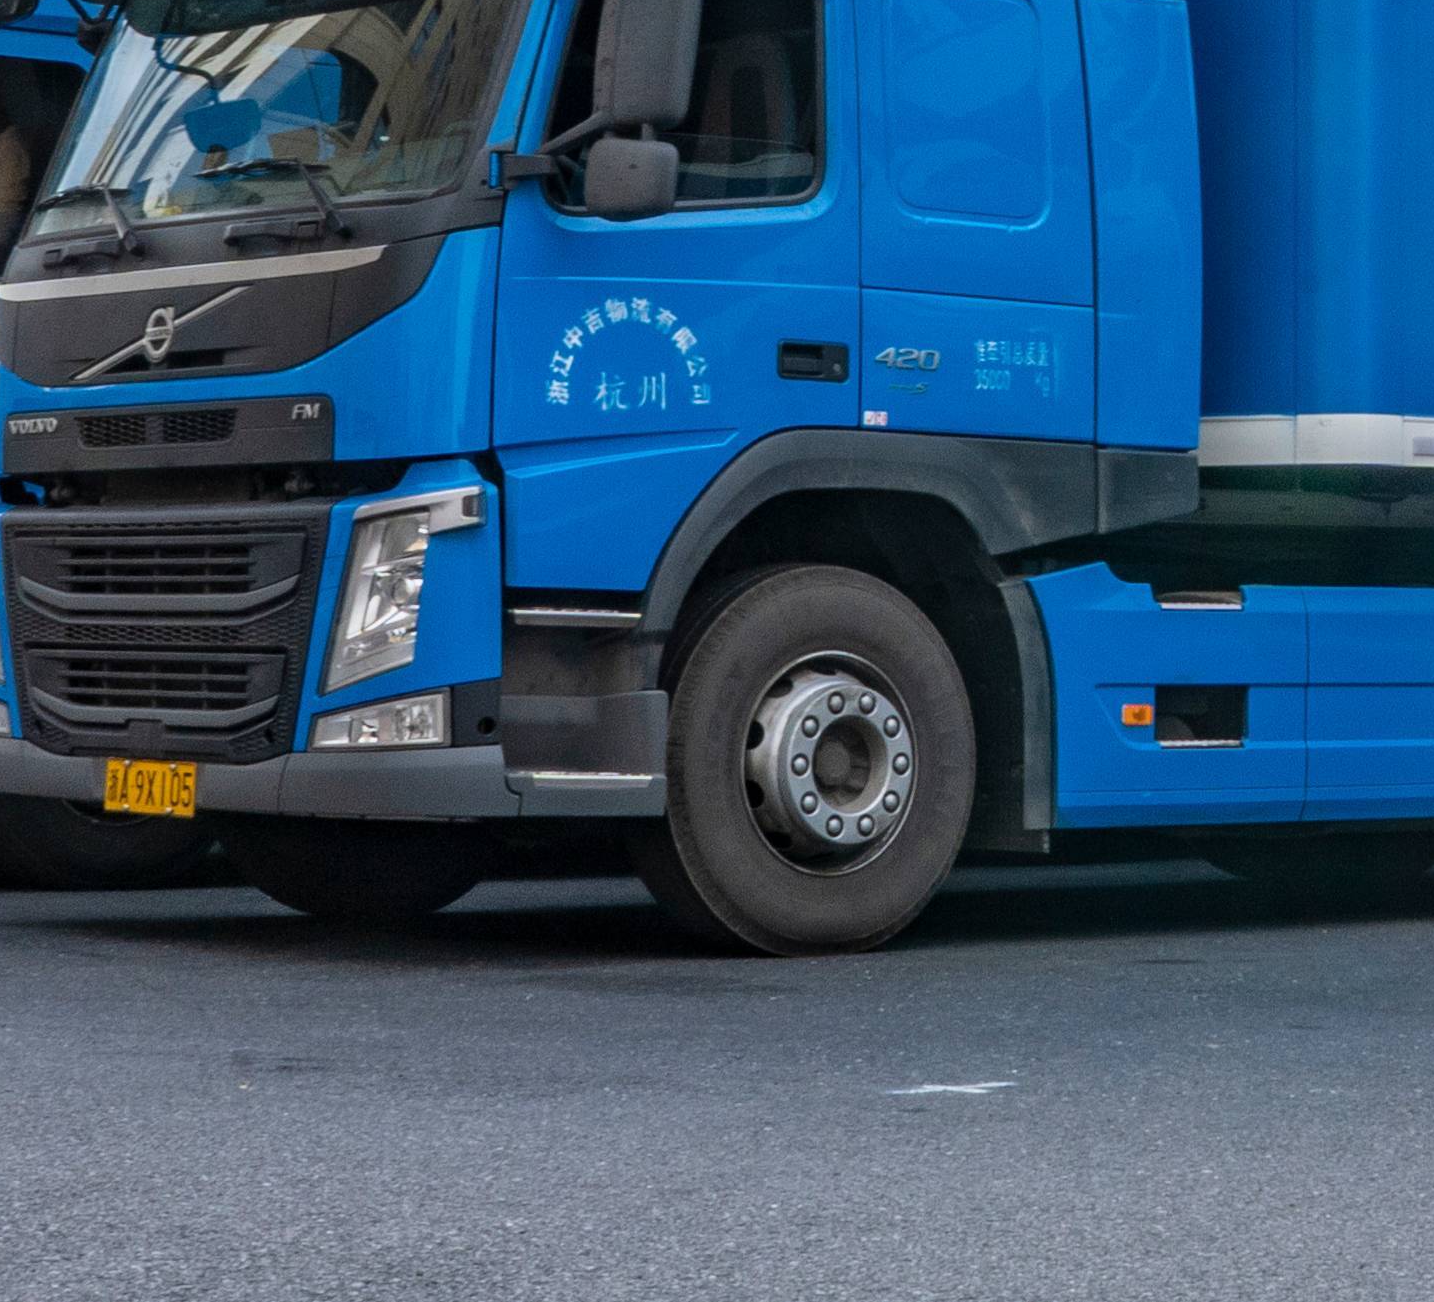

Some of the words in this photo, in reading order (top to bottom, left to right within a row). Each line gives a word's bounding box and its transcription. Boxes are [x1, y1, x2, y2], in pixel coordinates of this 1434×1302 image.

[875, 347, 941, 371] 420
[595, 372, 667, 411] 杭州
[291, 403, 320, 420] FM
[8, 417, 58, 435] VOLVO
